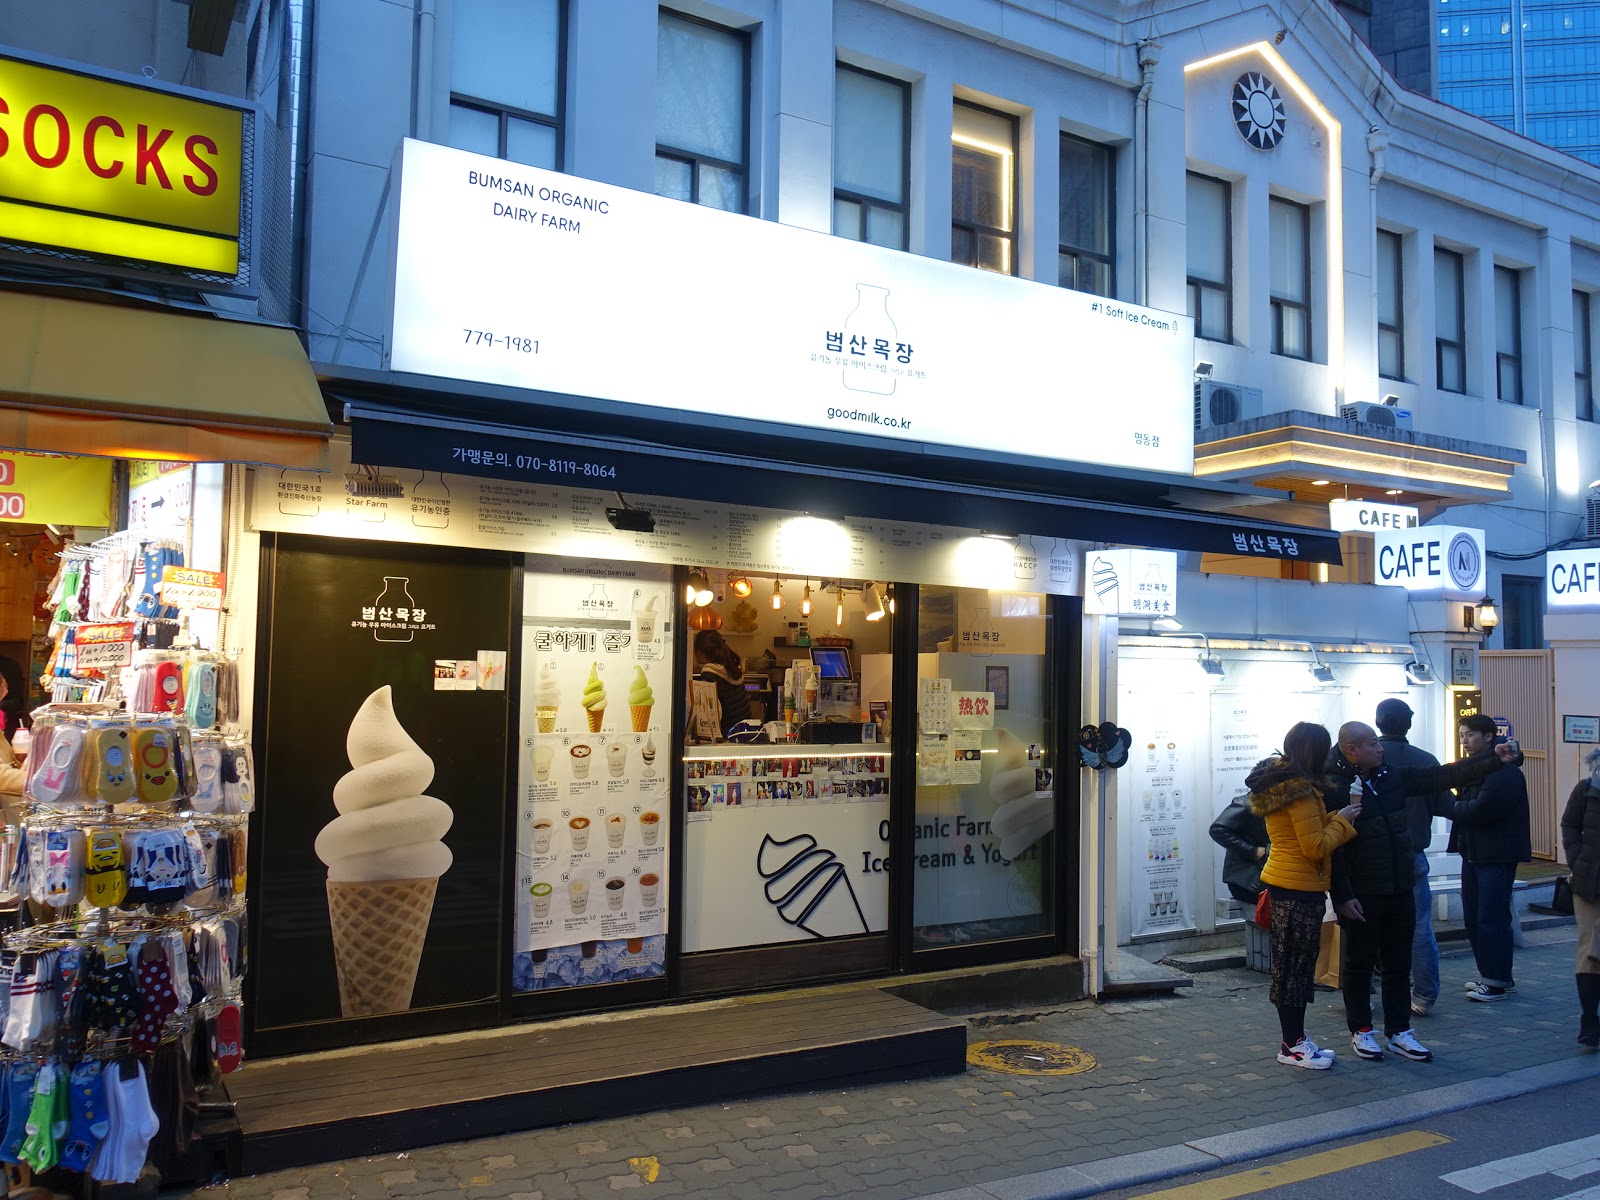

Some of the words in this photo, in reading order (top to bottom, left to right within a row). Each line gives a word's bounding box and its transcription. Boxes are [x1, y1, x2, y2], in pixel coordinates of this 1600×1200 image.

[0, 96, 219, 197] OCKS
[468, 170, 535, 198] BUMSAN
[538, 187, 610, 215] ORGANIC
[493, 202, 538, 224] DAIRY
[541, 213, 581, 234] FARM
[1091, 302, 1103, 314] #1
[1106, 305, 1124, 319] Soft
[1125, 310, 1139, 323] Ice
[1140, 314, 1170, 331] Cream
[463, 328, 540, 354] 779-1981
[826, 330, 914, 364] 범산목장
[827, 407, 912, 430] goodmilk.co.kr
[1134, 432, 1160, 448] 명동점
[516, 454, 617, 479] 070-8119-8064
[278, 481, 322, 493] 대한민국1호
[346, 497, 364, 506] Star
[366, 499, 388, 509] Farm
[411, 503, 451, 516] 유기농인증
[1358, 509, 1401, 529] CAFE
[1406, 514, 1417, 528] M
[1231, 532, 1300, 557] 범산목장
[1013, 561, 1037, 570] HACCP
[1379, 540, 1441, 580] CAFE
[177, 572, 211, 585] SALE
[1139, 583, 1168, 592] 범산목장
[582, 599, 614, 608] 범산목장
[362, 606, 427, 622] 범산목장
[351, 620, 367, 628] 유기농
[89, 629, 121, 641] SALE
[535, 630, 596, 652] 쿨하게!
[962, 631, 1000, 641] 범산목장
[958, 697, 990, 716] 热饮
[1459, 708, 1471, 717] CAFE
[879, 816, 950, 842] Oanic
[862, 851, 890, 873] Ice
[912, 850, 956, 869] ream
[963, 844, 975, 865] &
